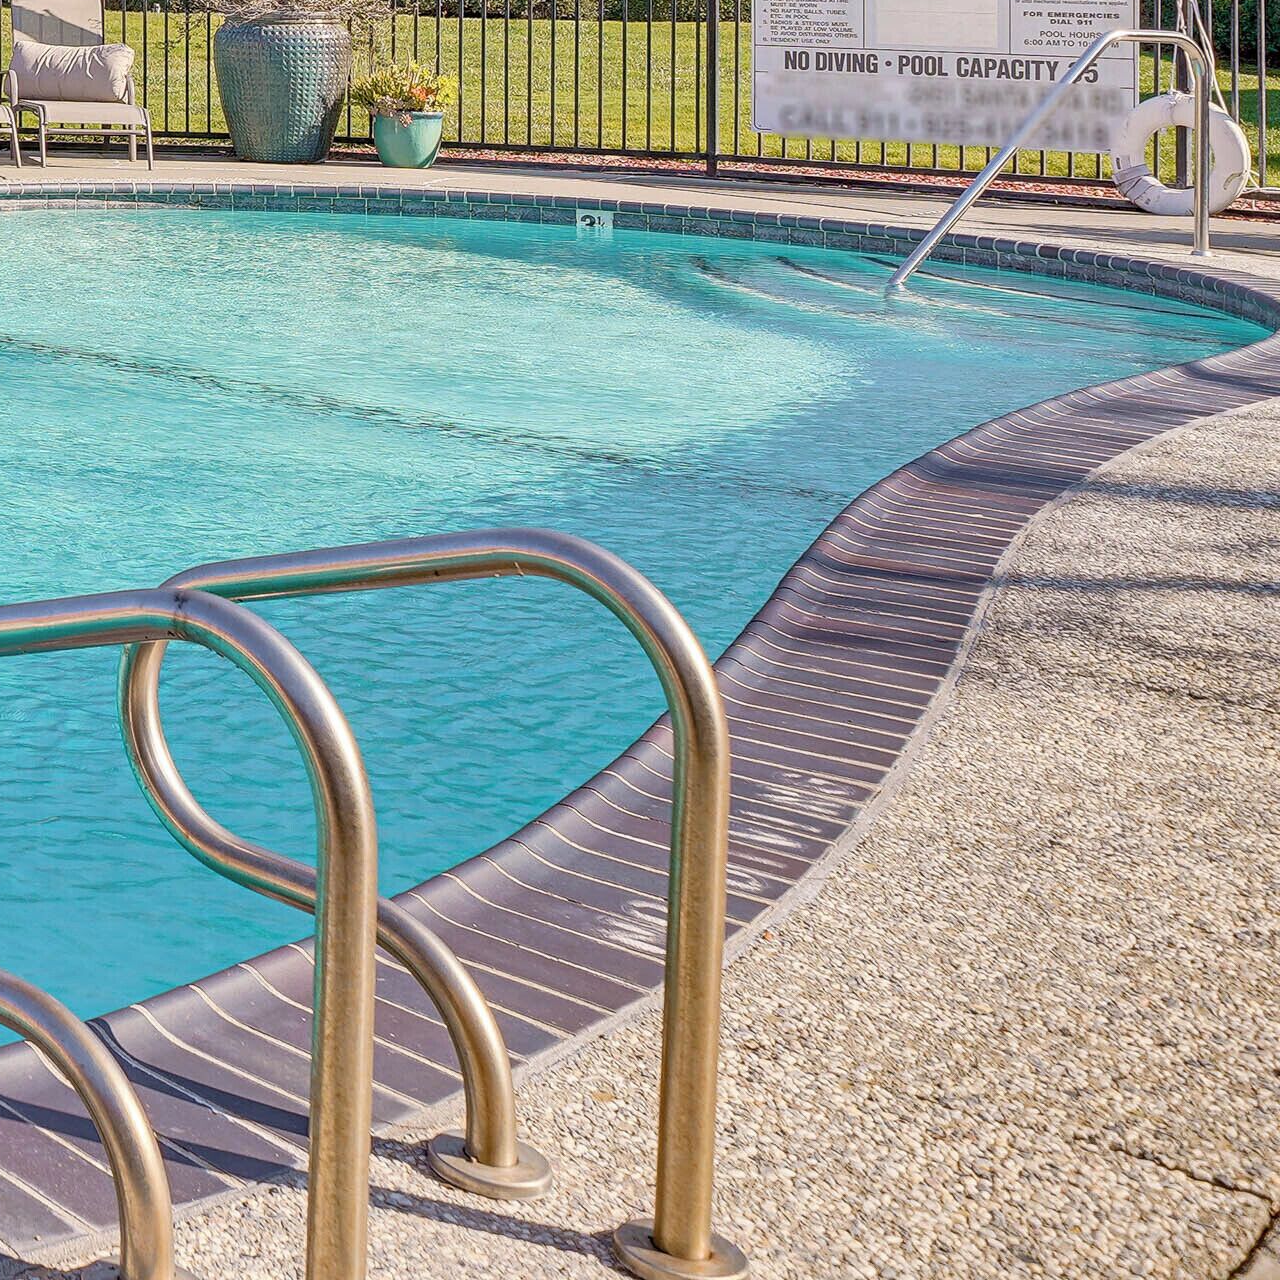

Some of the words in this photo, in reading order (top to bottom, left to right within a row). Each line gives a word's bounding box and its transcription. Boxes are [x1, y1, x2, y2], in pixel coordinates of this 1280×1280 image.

[784, 51, 809, 70] NO
[815, 52, 878, 74] DIVING
[898, 55, 948, 76] POOL
[956, 57, 1059, 81] CAPACITY
